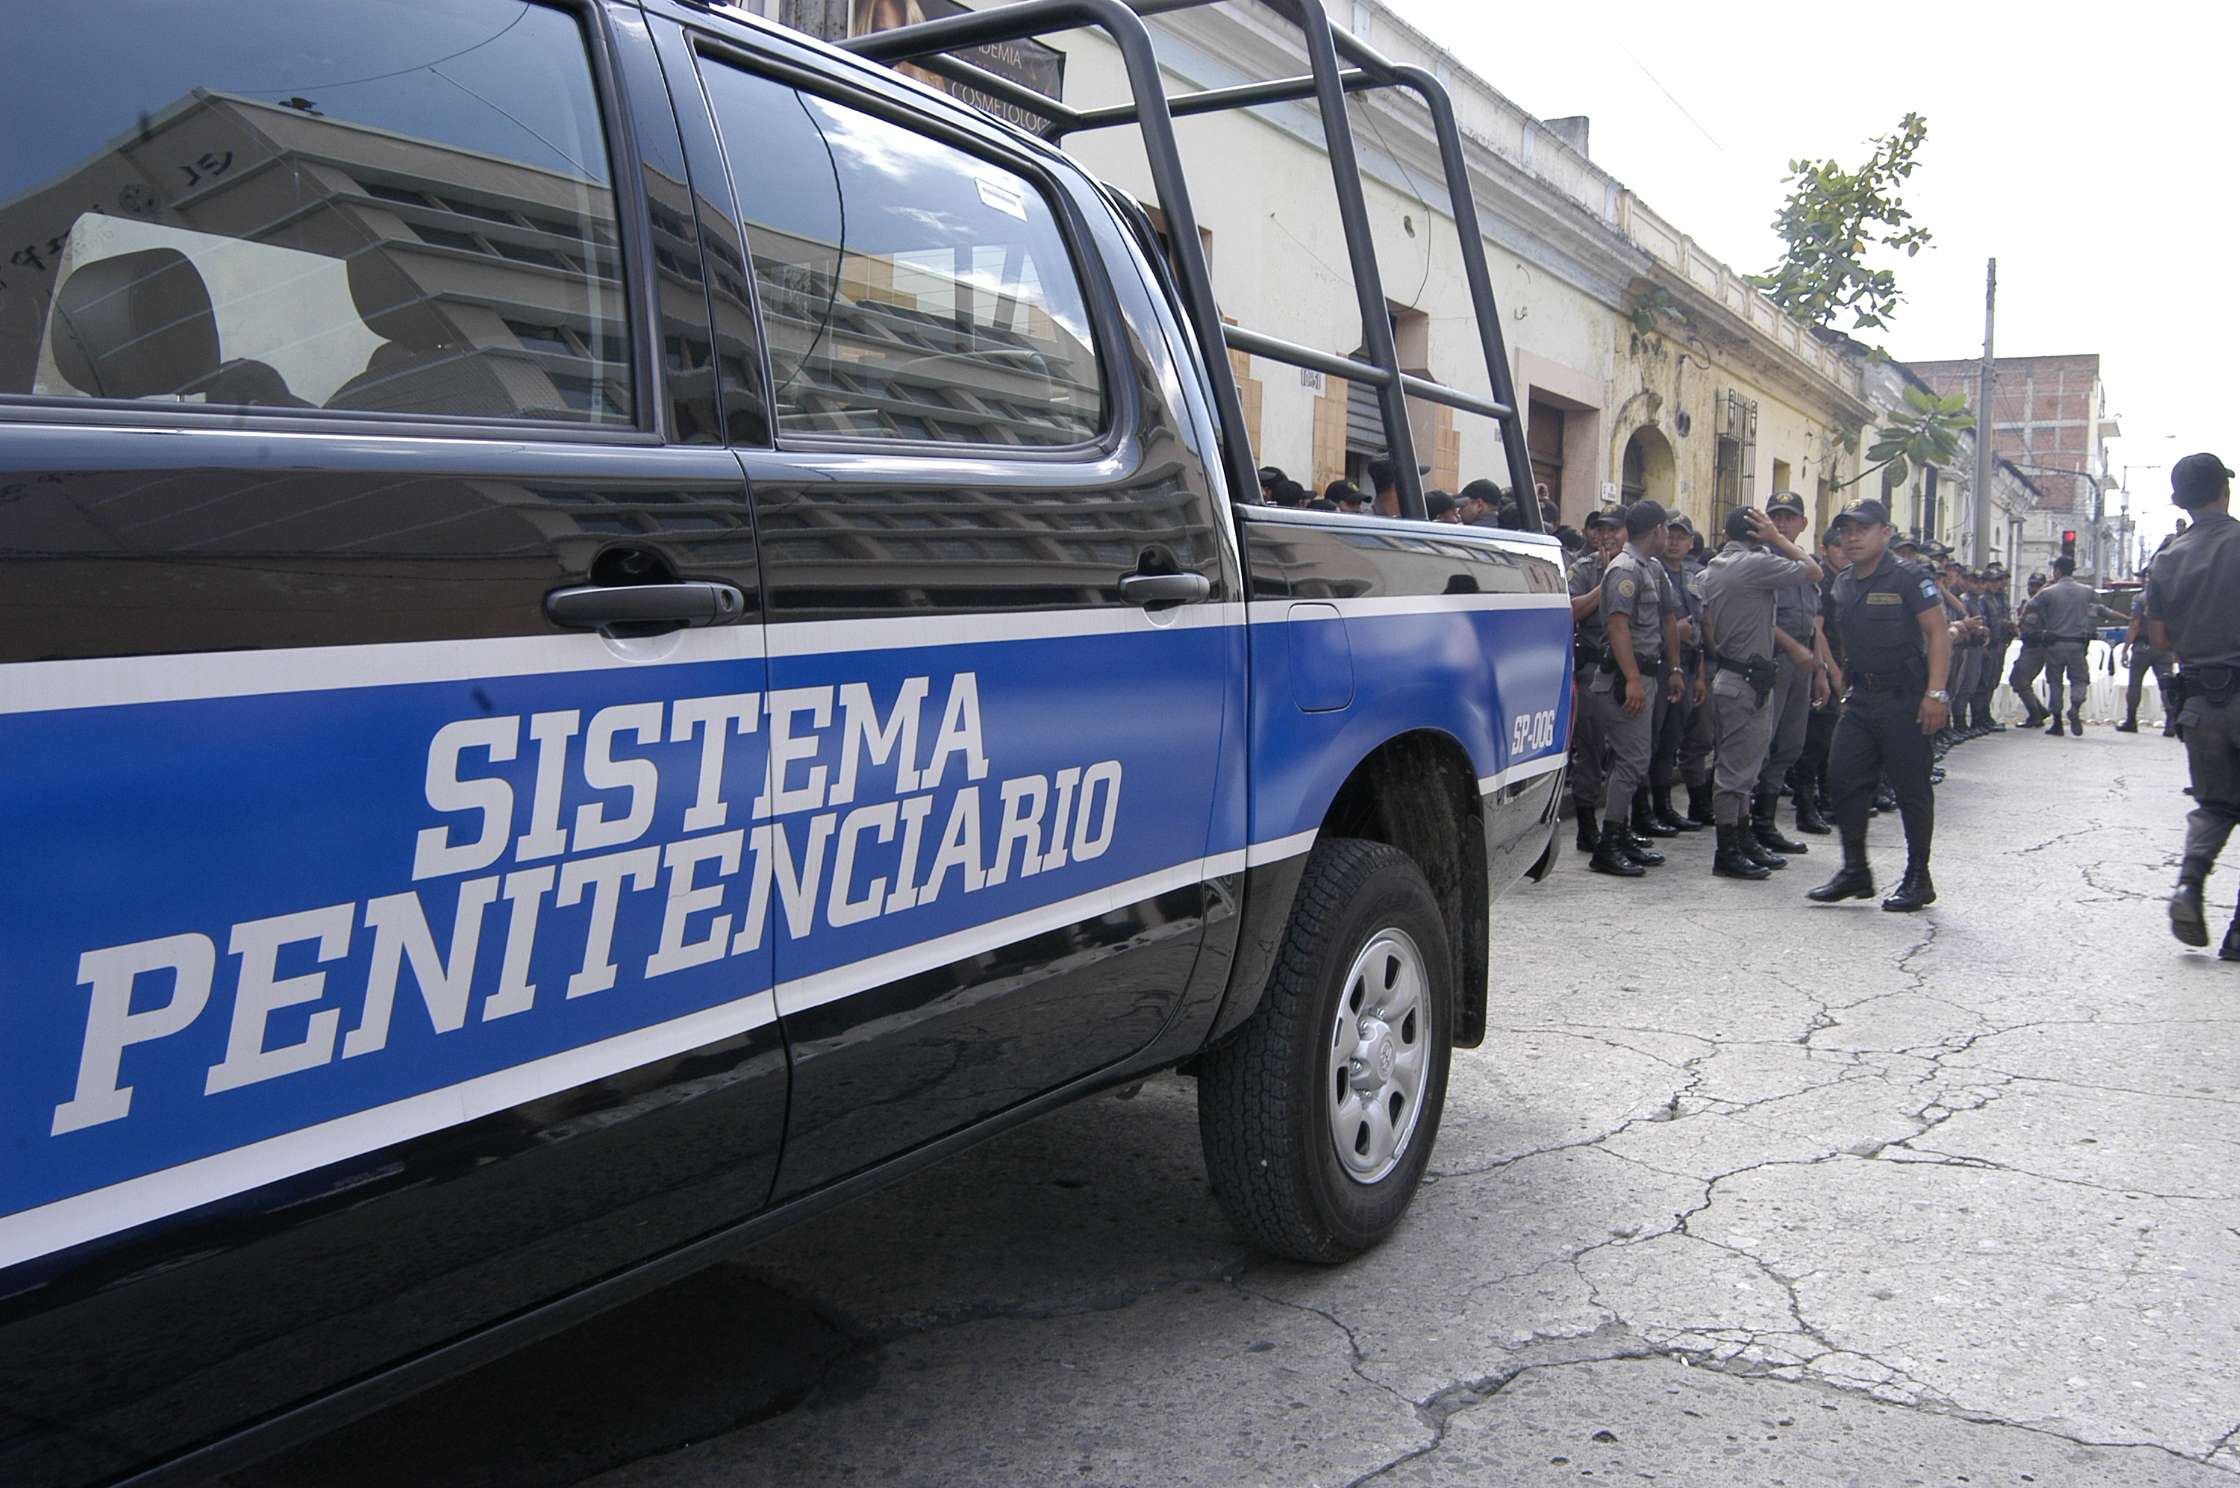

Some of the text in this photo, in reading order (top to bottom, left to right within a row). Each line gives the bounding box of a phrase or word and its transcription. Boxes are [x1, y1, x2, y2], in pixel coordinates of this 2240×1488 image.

[978, 42, 1023, 70] DEMIA
[411, 671, 990, 881] SISTEMA
[1511, 709, 1555, 756] SP-006
[50, 759, 1123, 1137] PENITENCIARIO
